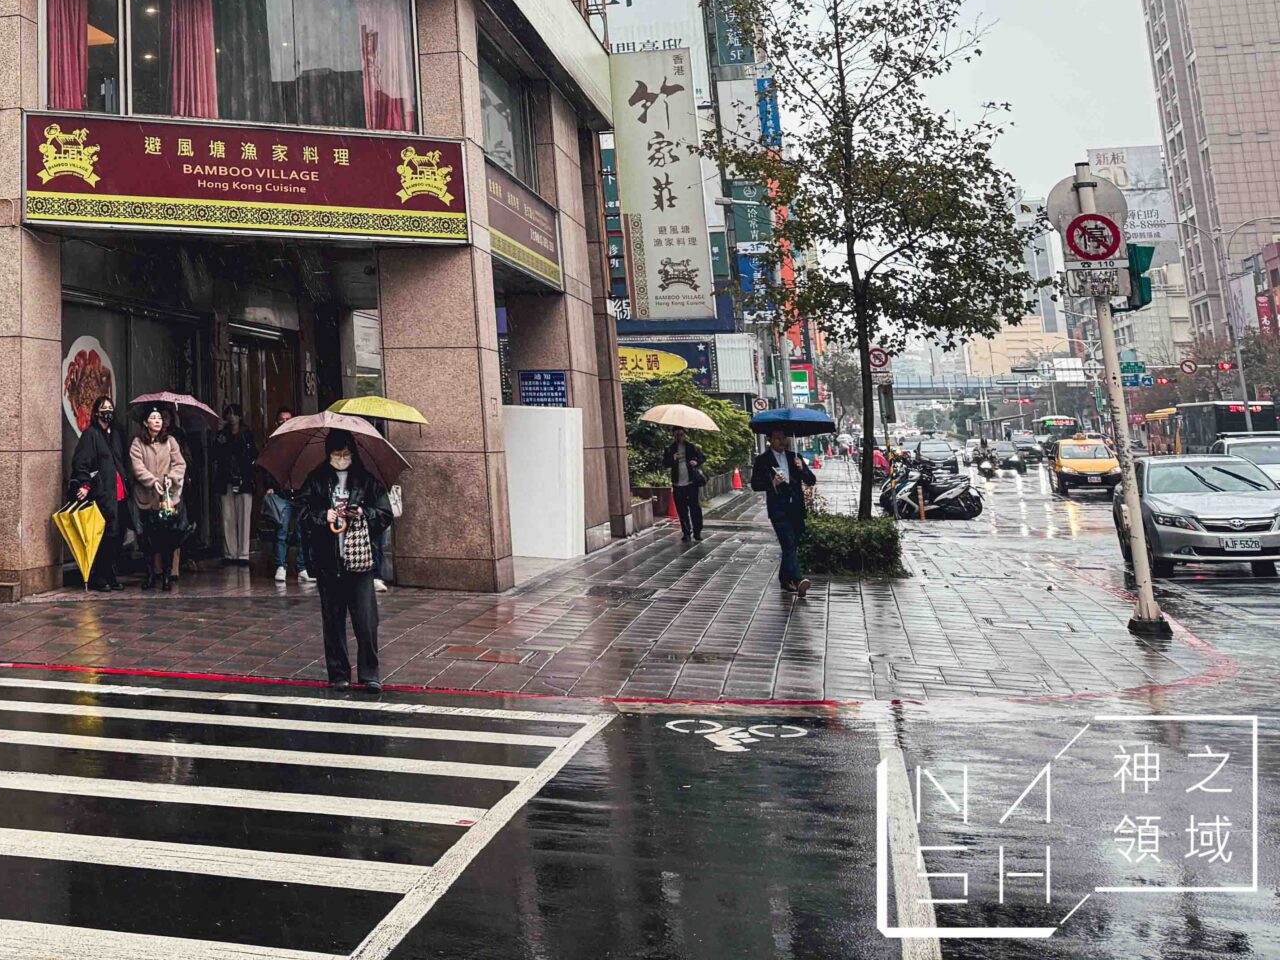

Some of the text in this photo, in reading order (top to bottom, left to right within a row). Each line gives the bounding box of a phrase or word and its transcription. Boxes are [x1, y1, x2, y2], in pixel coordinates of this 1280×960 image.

[730, 49, 744, 61] 5F
[672, 54, 685, 76] 香港
[144, 136, 350, 167] 避風塘漁家料理
[183, 163, 320, 182] BAMBOO VILLAGE
[197, 180, 307, 194] Hong Kong Cuisine
[657, 225, 691, 235] 避風塘
[653, 237, 698, 247] 漁家料理
[682, 293, 705, 301] VILLAGE
